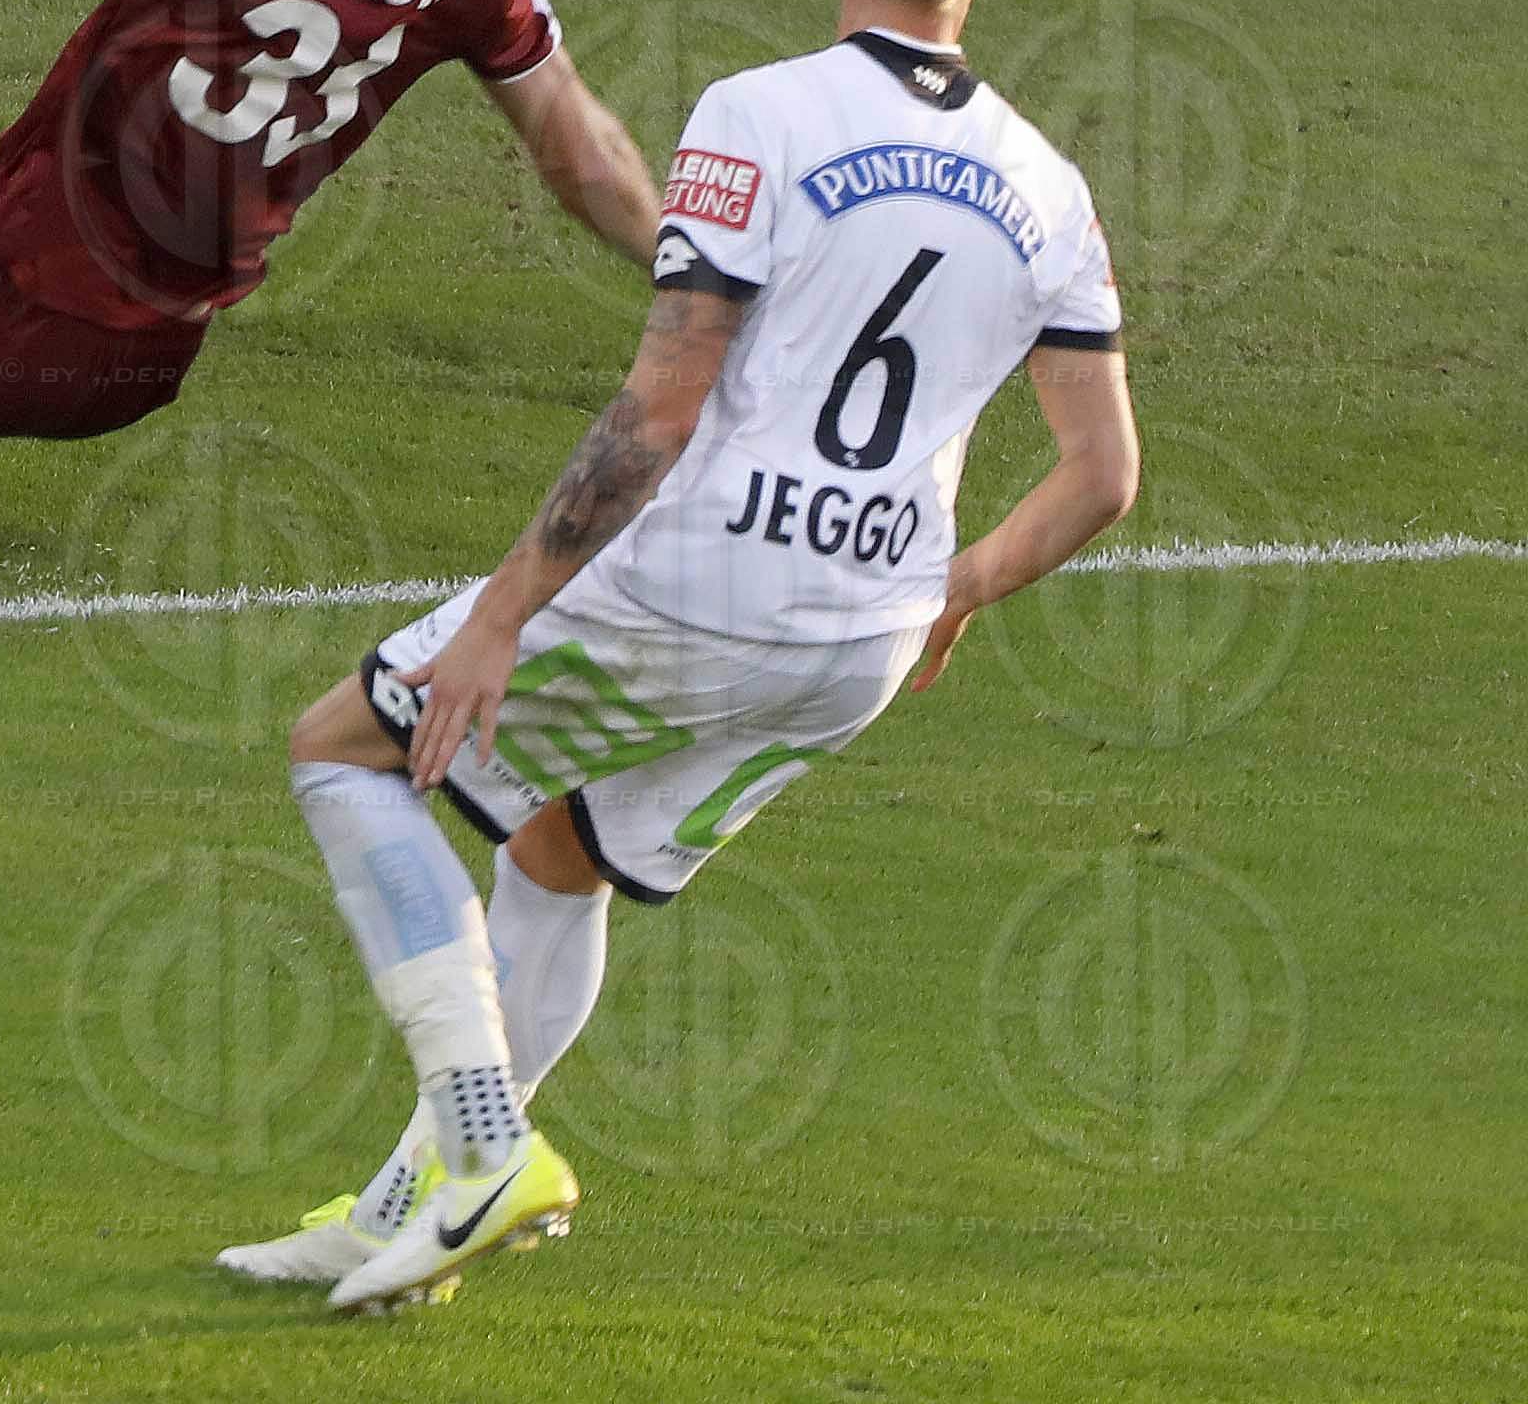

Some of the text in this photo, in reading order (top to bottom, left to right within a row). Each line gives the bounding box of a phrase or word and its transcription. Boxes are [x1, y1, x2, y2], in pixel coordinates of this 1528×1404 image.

[810, 149, 1046, 255] PUNTIGAMER
[814, 249, 945, 471] 6
[726, 471, 918, 566] JEGGO
